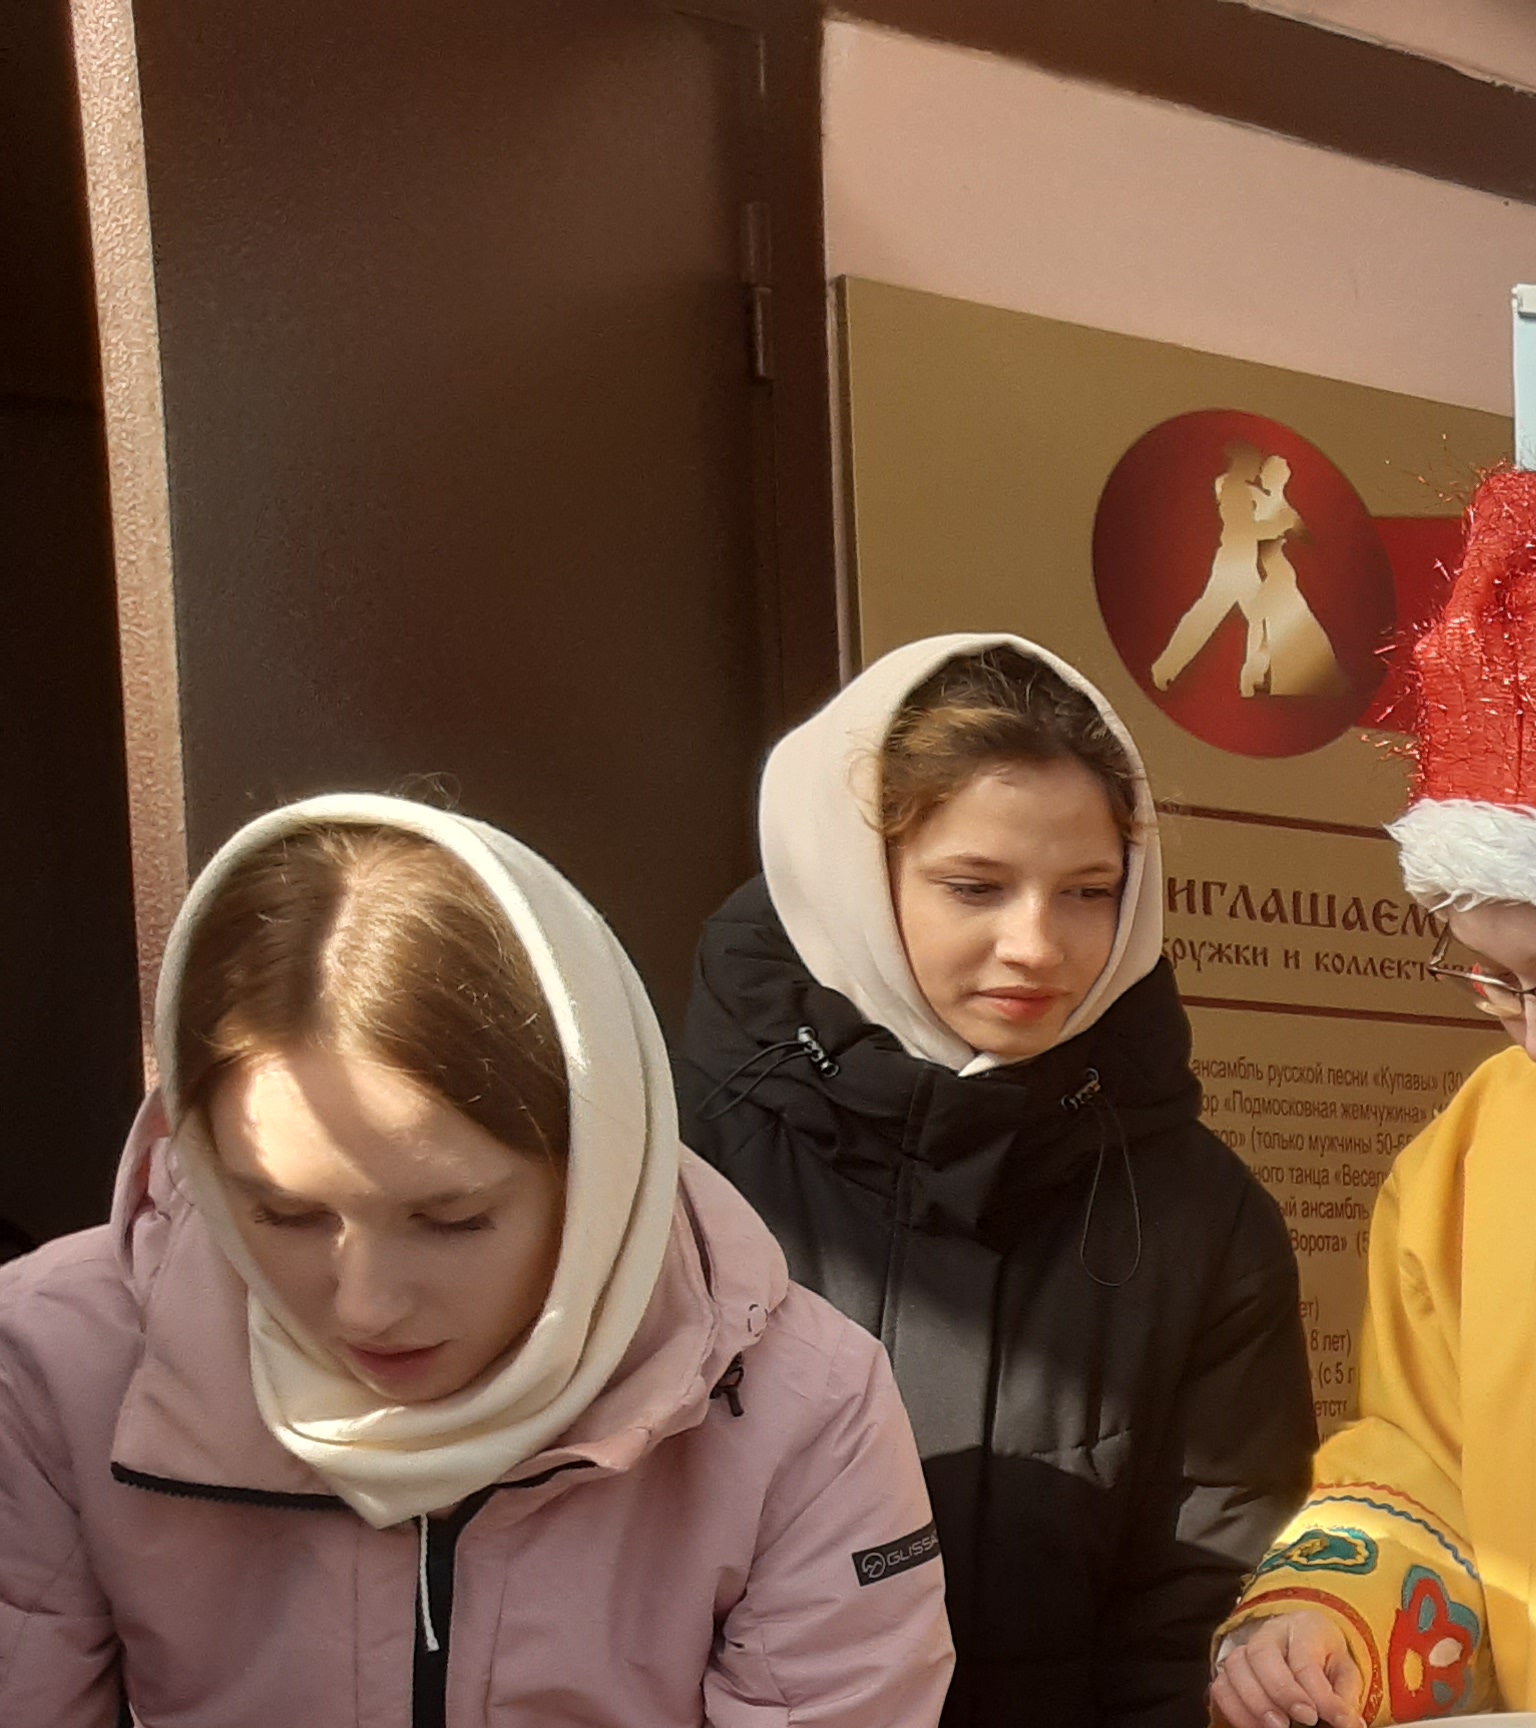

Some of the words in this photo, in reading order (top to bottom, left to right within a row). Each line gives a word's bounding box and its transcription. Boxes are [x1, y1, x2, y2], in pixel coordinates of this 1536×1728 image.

[1165, 874, 1442, 940] ИГЛАШАЕМ
[1268, 1063, 1323, 1088] русской
[1327, 1067, 1369, 1087] песни
[1202, 1094, 1219, 1117] ор
[1224, 1090, 1338, 1119] «Подмосковная
[1340, 1102, 1427, 1127] жемчужина»
[1251, 1126, 1305, 1152] (только
[1309, 1133, 1373, 1158] мужчины
[1289, 1167, 1330, 1190] танца
[1301, 1196, 1370, 1220] ансамбль
[1300, 1296, 1319, 1320] ет)
[1323, 1328, 1351, 1358] лет)
